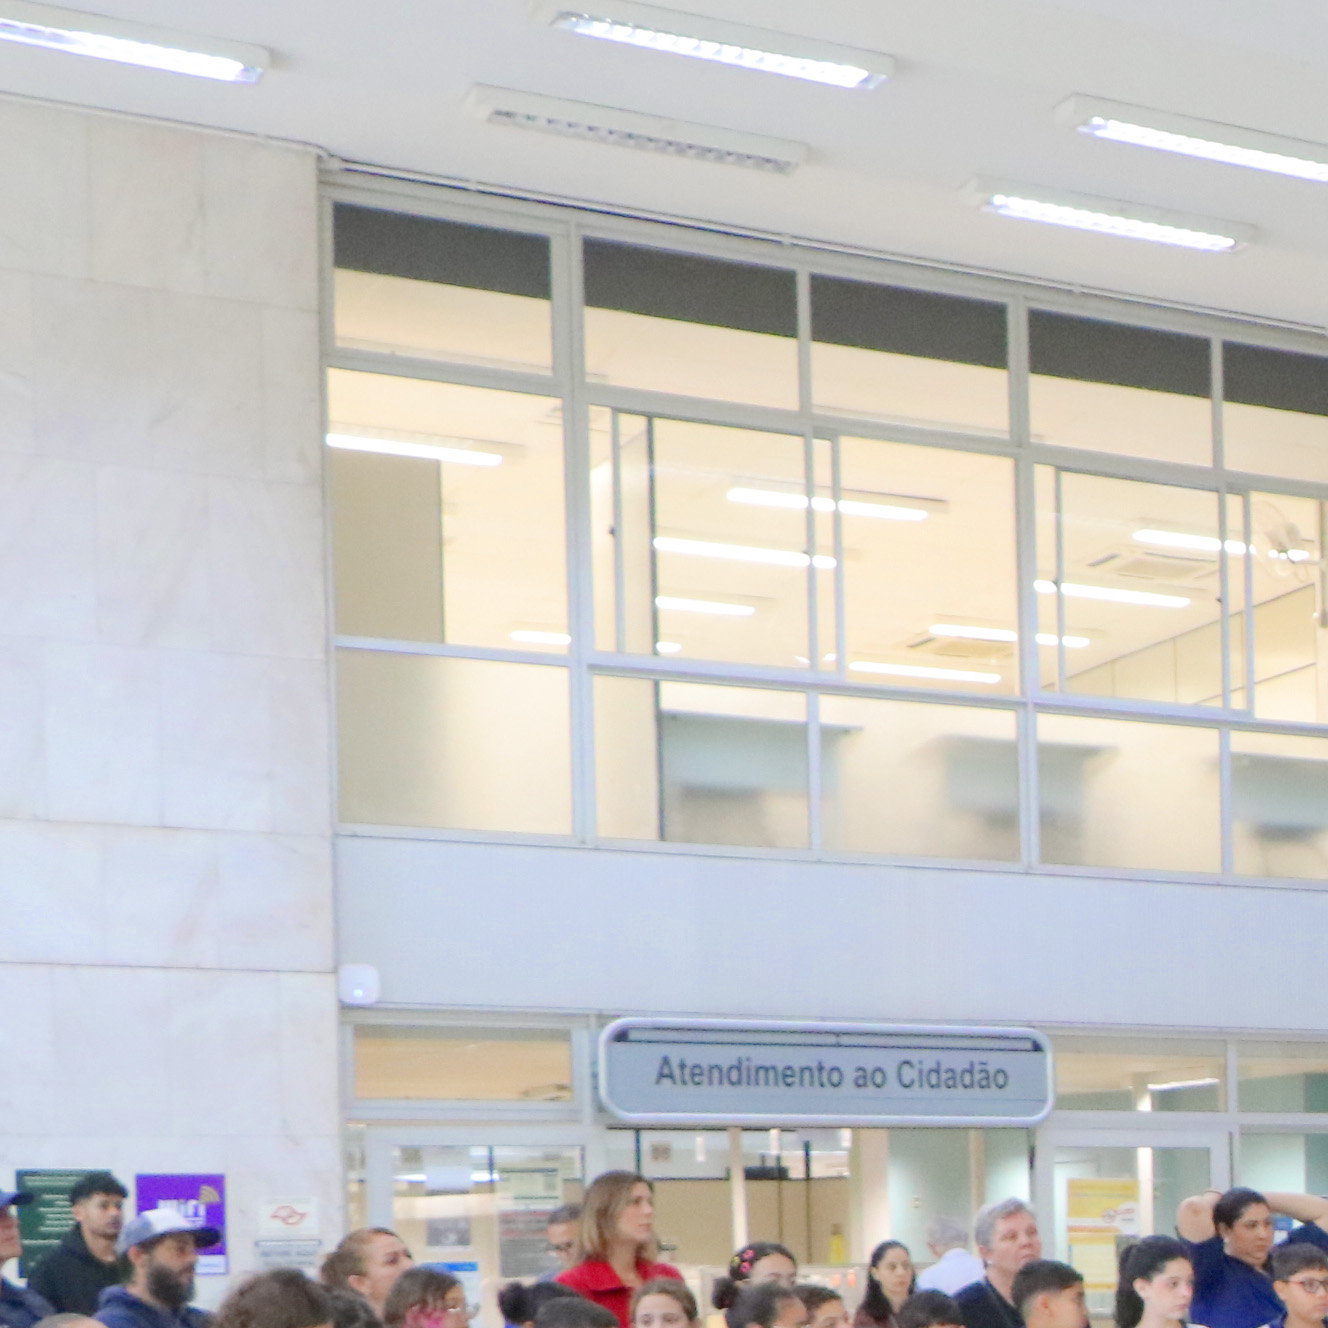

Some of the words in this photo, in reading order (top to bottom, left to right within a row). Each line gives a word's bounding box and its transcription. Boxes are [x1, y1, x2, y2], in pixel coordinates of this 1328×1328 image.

[655, 1055, 844, 1088] Atendimento
[853, 1066, 887, 1088] ao
[897, 1060, 1009, 1089] Cidadão
